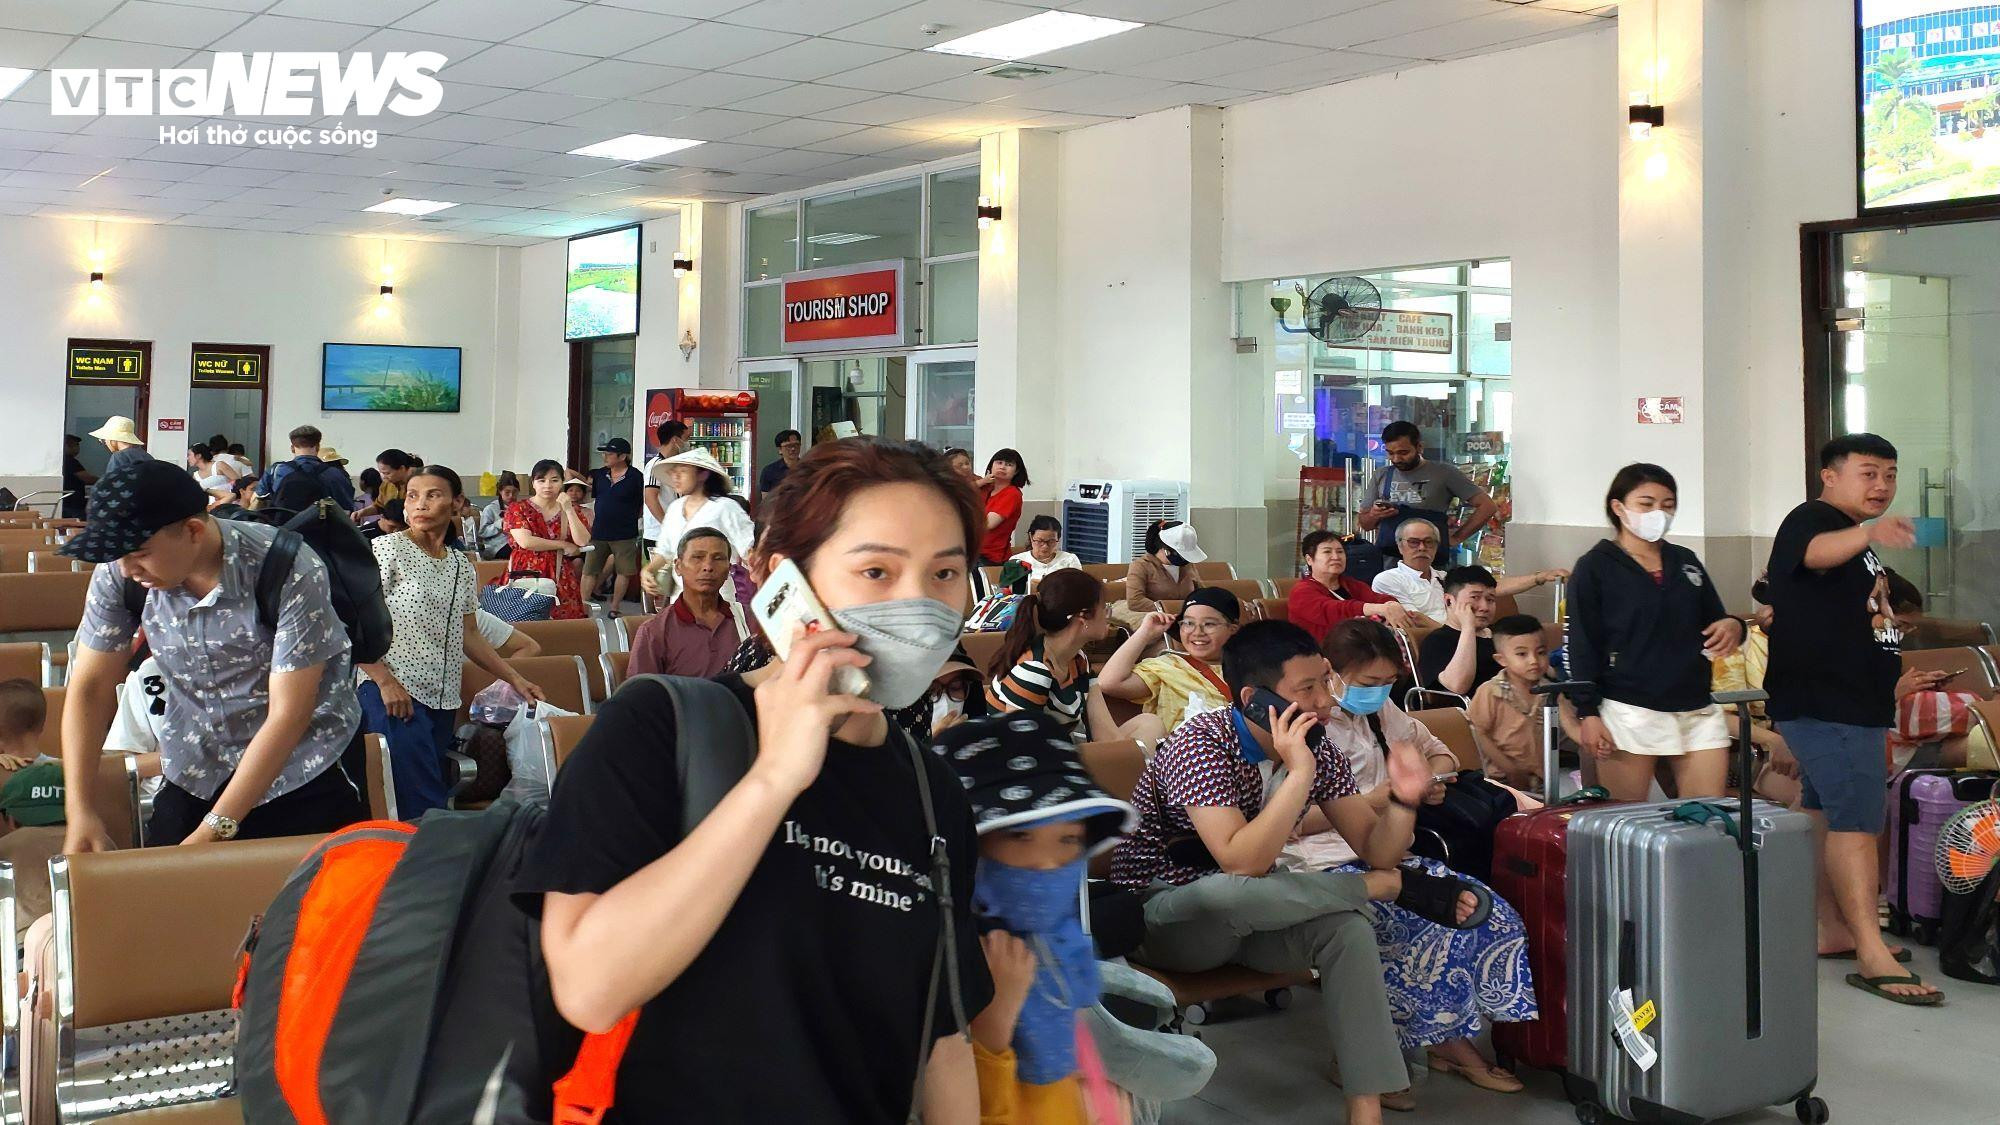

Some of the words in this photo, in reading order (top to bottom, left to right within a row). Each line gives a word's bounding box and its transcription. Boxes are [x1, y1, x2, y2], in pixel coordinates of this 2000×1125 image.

[786, 297, 846, 323] TOURISM
[848, 292, 889, 317] SHOP
[93, 357, 114, 365] NAM
[198, 360, 213, 368] WC
[1466, 441, 1492, 452] POCA
[31, 785, 65, 799] BUT
